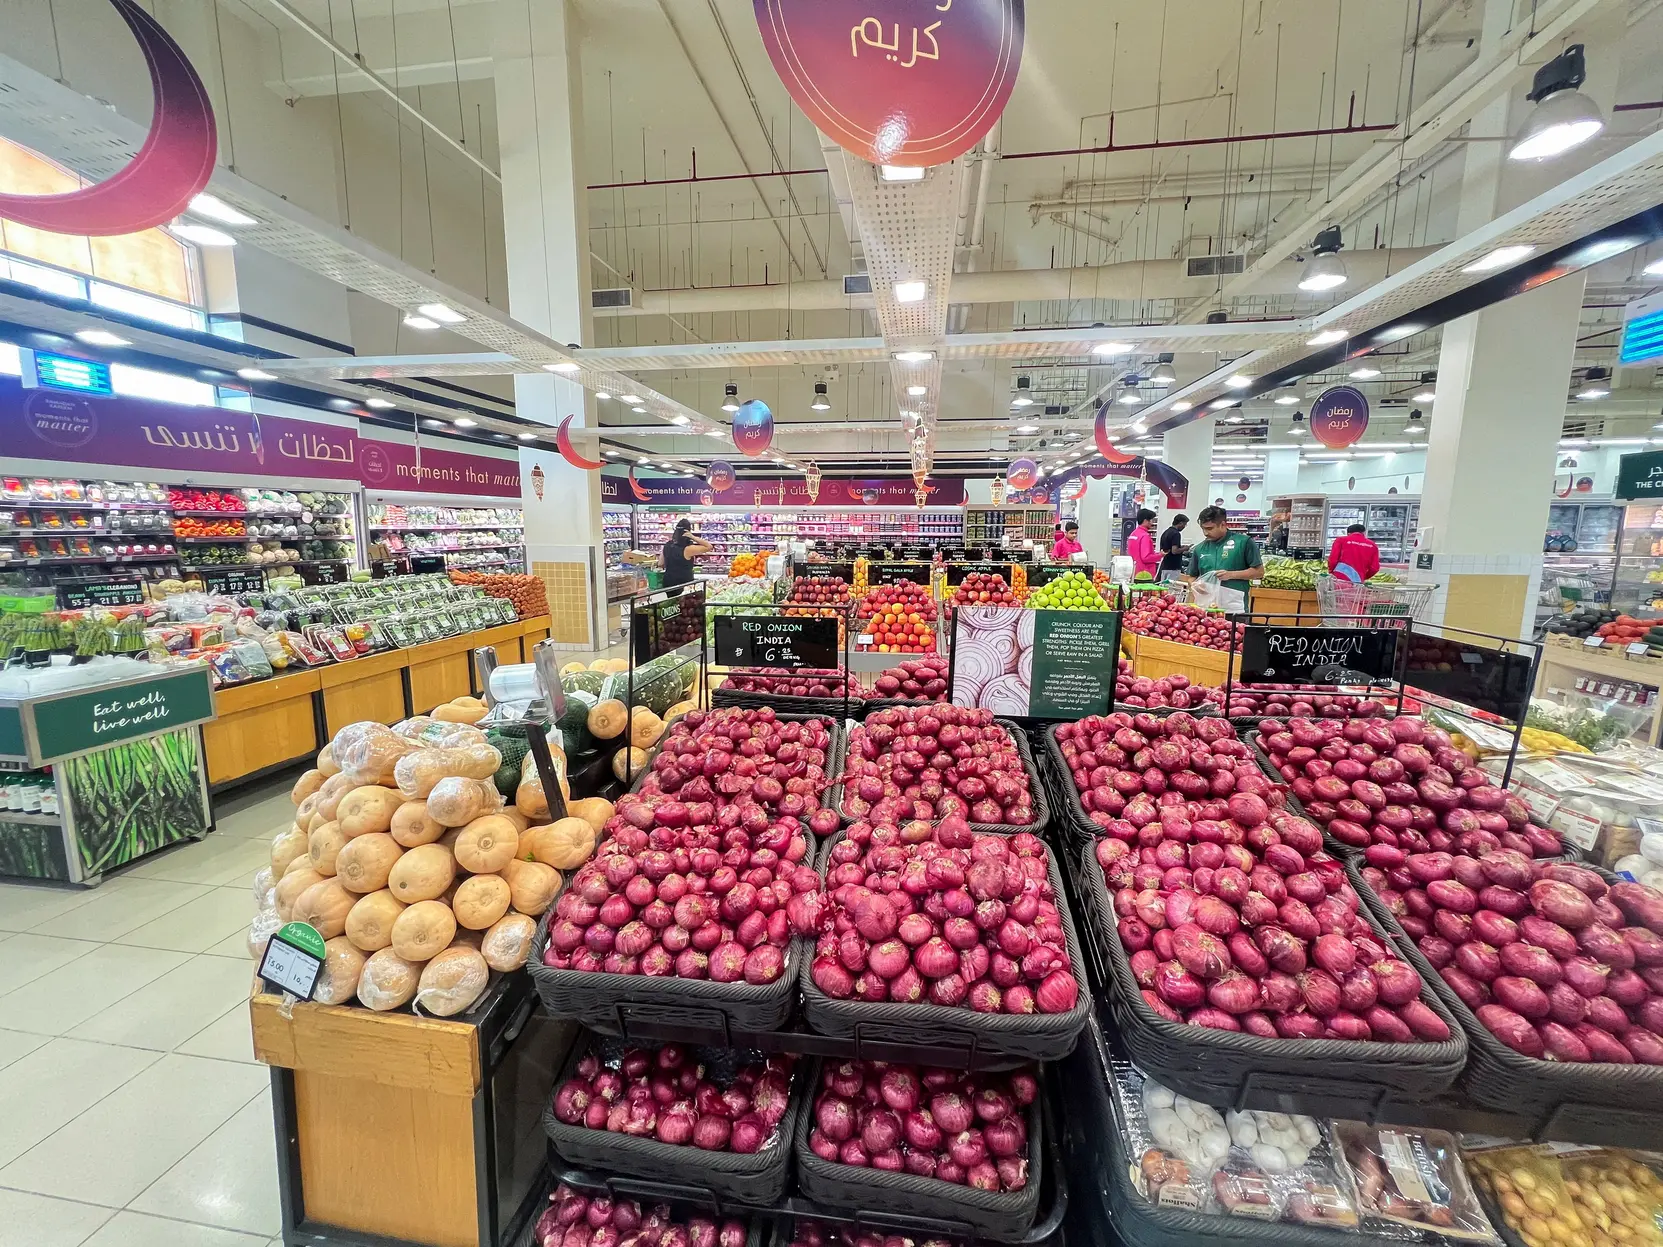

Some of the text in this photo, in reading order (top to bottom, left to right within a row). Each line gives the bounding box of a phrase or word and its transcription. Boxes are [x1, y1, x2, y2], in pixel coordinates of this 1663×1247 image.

[850, 17, 941, 67] كريم
[1327, 406, 1354, 418] رمضان
[36, 419, 90, 434] matter
[1328, 419, 1350, 430] كريم
[141, 424, 240, 453] تنسى
[278, 432, 354, 463] لحظات
[465, 466, 490, 485] that
[493, 474, 521, 487] matt
[678, 484, 693, 496] that
[889, 485, 907, 495] that
[1635, 481, 1653, 489] THE
[742, 622, 803, 632] RED ONION
[756, 635, 792, 645] INDIA
[1268, 634, 1363, 654] RED ONION
[1291, 653, 1348, 666] INDIA
[93, 700, 123, 717] Eat
[93, 706, 170, 734] live well
[1412, 1140, 1433, 1177] British
[1161, 1198, 1196, 1208] Shallots
